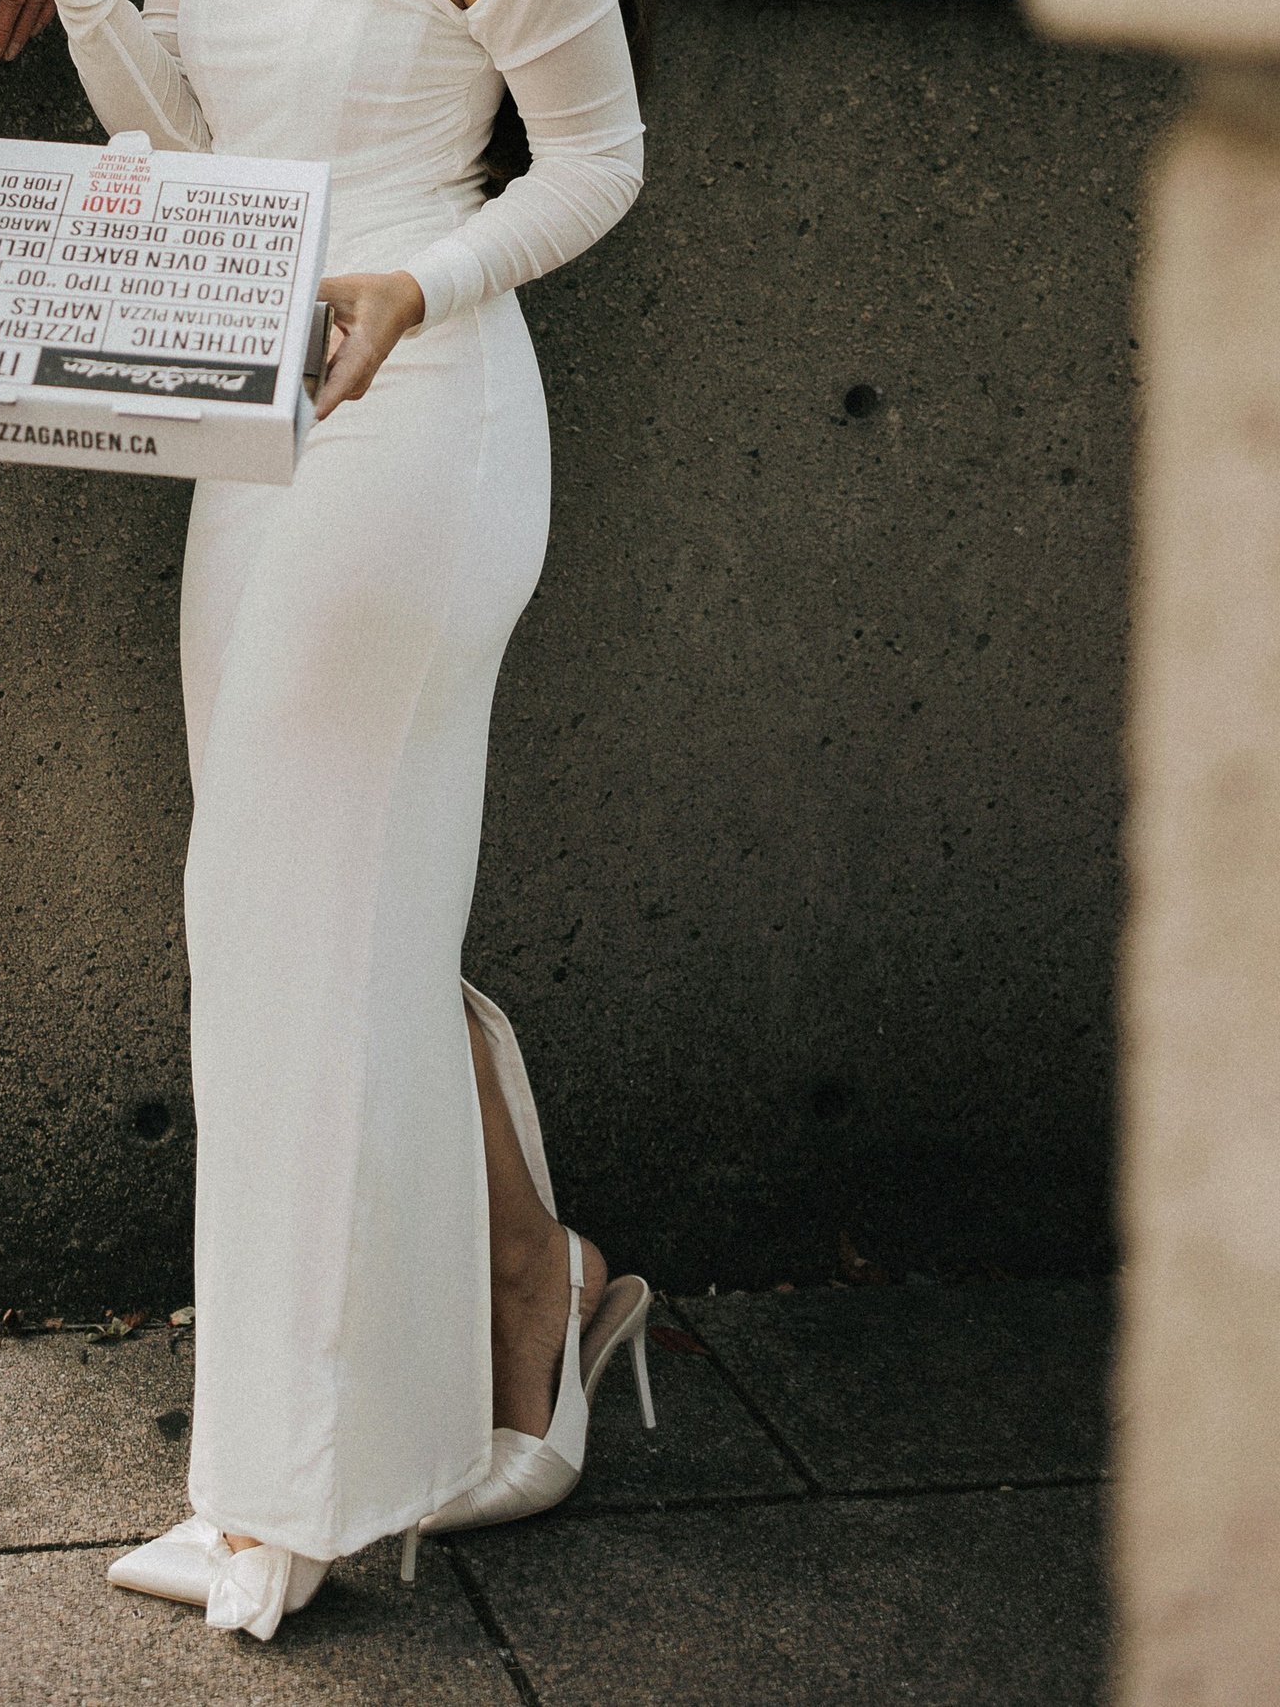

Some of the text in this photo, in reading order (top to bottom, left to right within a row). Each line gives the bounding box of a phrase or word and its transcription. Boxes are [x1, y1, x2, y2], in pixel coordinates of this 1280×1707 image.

[101, 153, 137, 164] ITALIAN
[89, 171, 150, 182] HOW FRIENDS
[134, 166, 150, 174] SAY
[1, 175, 20, 189] DI
[24, 177, 62, 192] FIOR
[89, 180, 142, 194] THAT'S
[81, 195, 142, 216] CIAO!
[186, 189, 300, 211] FANTASTICA
[162, 206, 298, 229] MARAVILHOSA
[70, 220, 168, 243] DEGREES
[232, 232, 258, 250] TO
[265, 235, 294, 252] UP
[61, 244, 290, 278] STONE OVEN BAKED
[65, 273, 111, 293] TIPO
[120, 277, 191, 299] FLOUR
[197, 283, 285, 306] CAPUTO
[11, 297, 102, 321] NAPLES
[120, 305, 281, 330] NEAPOLITAN PIZZA
[131, 327, 276, 355] AUTHENTIC
[62, 360, 246, 391] Pizza Garden
